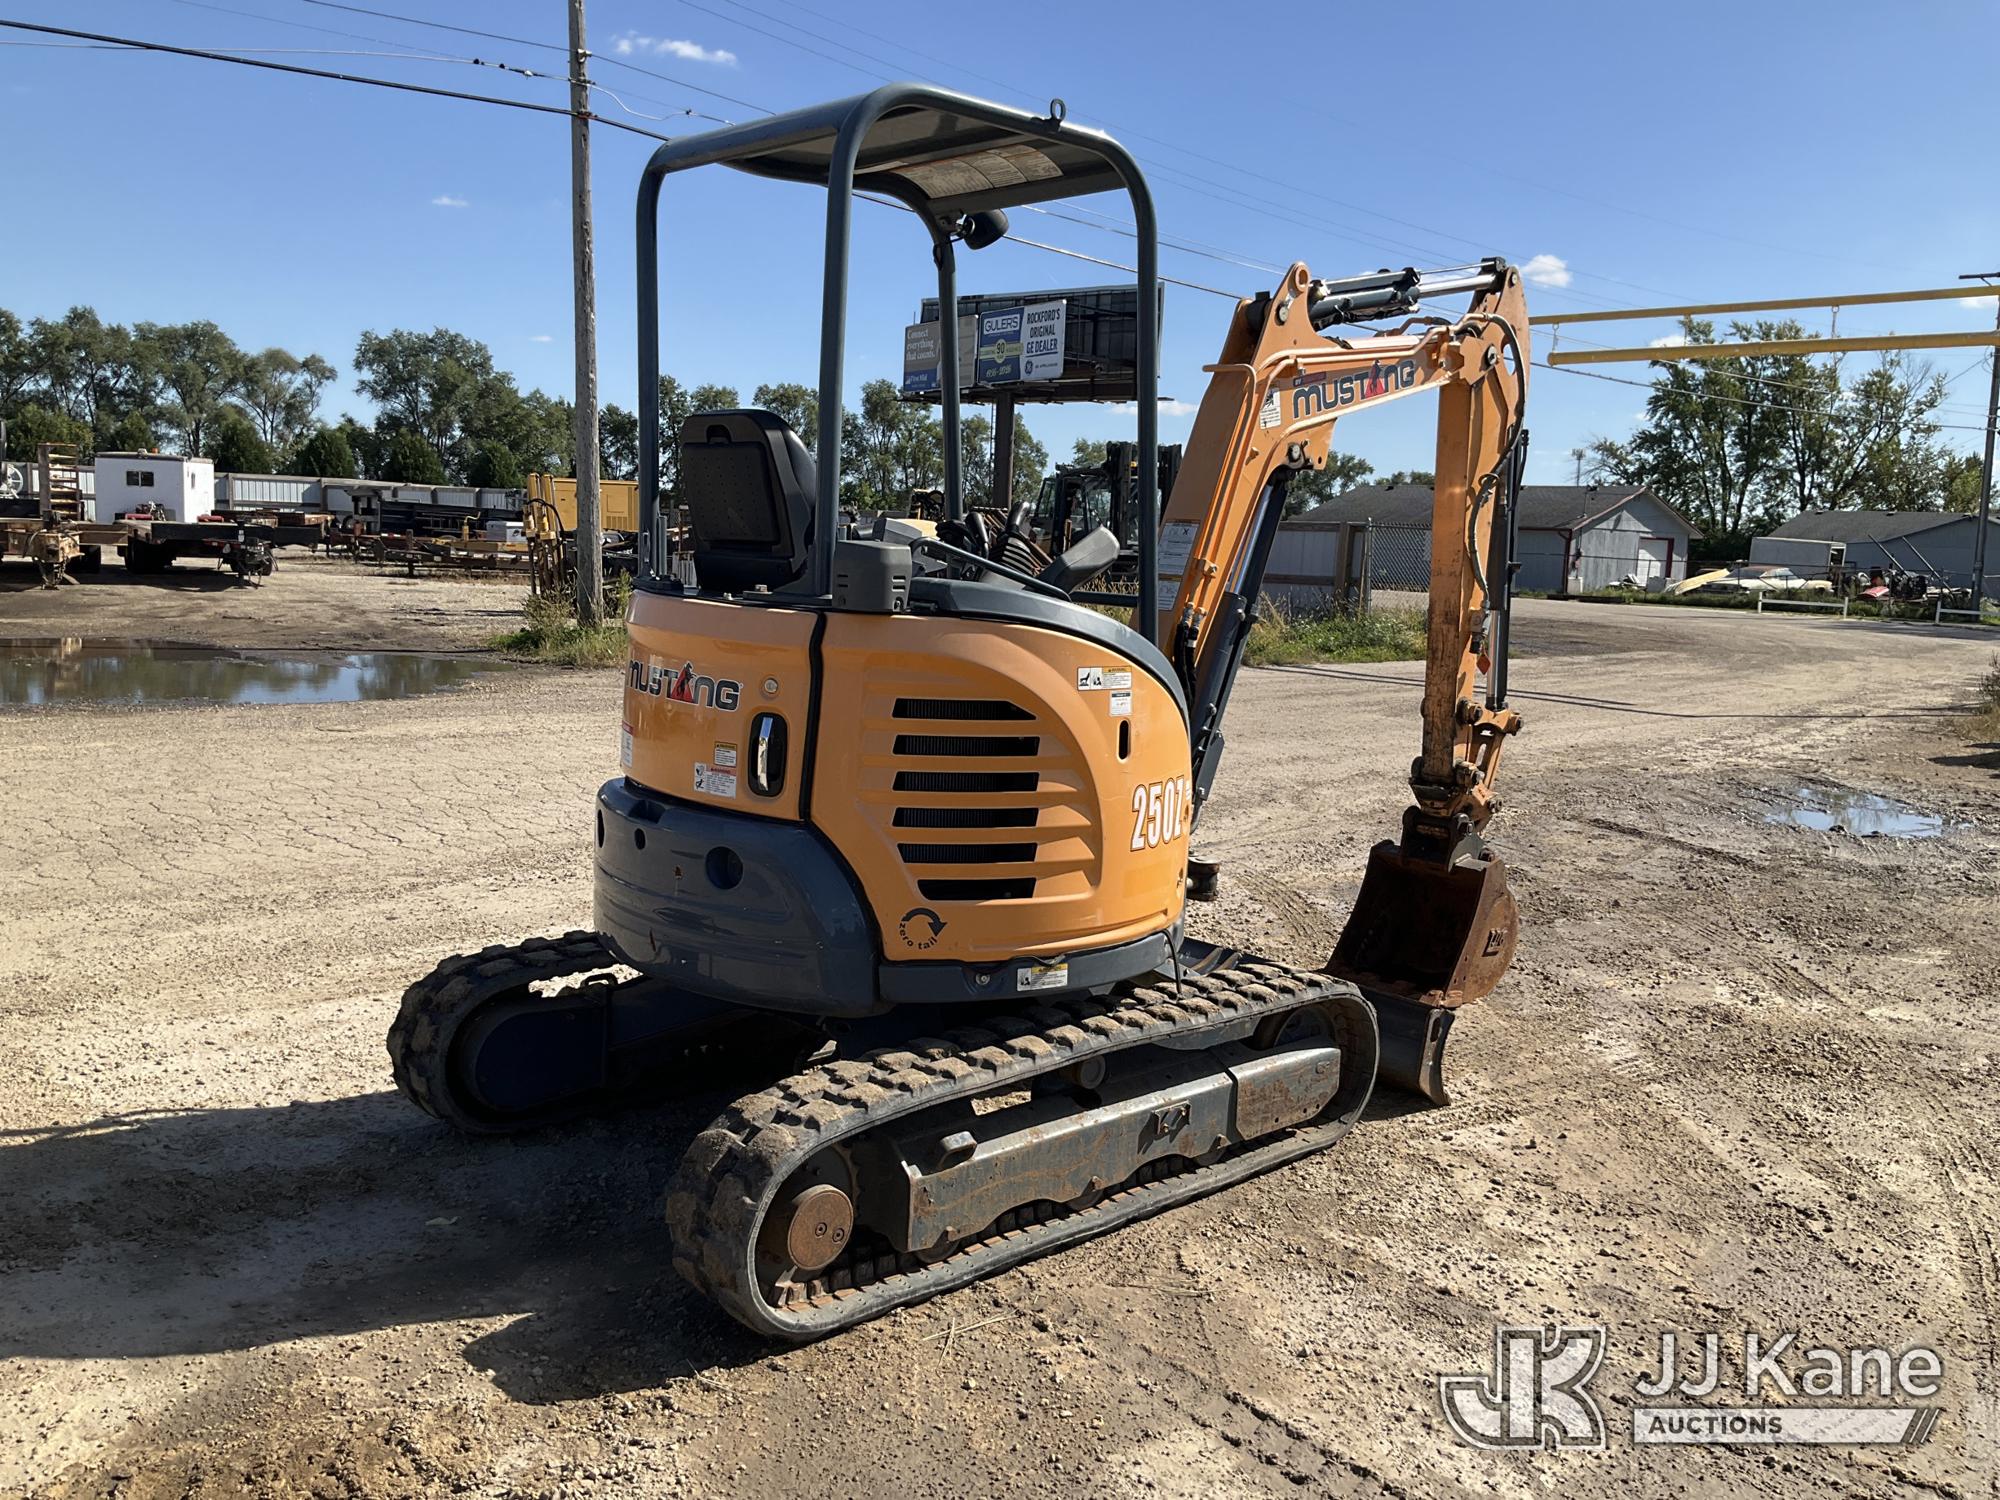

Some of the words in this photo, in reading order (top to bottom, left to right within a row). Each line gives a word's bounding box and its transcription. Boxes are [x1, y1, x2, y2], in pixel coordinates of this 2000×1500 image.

[1027, 308, 1060, 324] ROCKFORD'S
[1030, 324, 1055, 338] ORIGINAL
[996, 342, 1005, 354] 90
[1026, 341, 1034, 354] GE
[1035, 338, 1058, 353] DEALER
[1293, 359, 1415, 419] MUSTANG
[628, 659, 741, 713] MUSTANG
[899, 923, 914, 947] zero
[918, 936, 938, 950] tail
